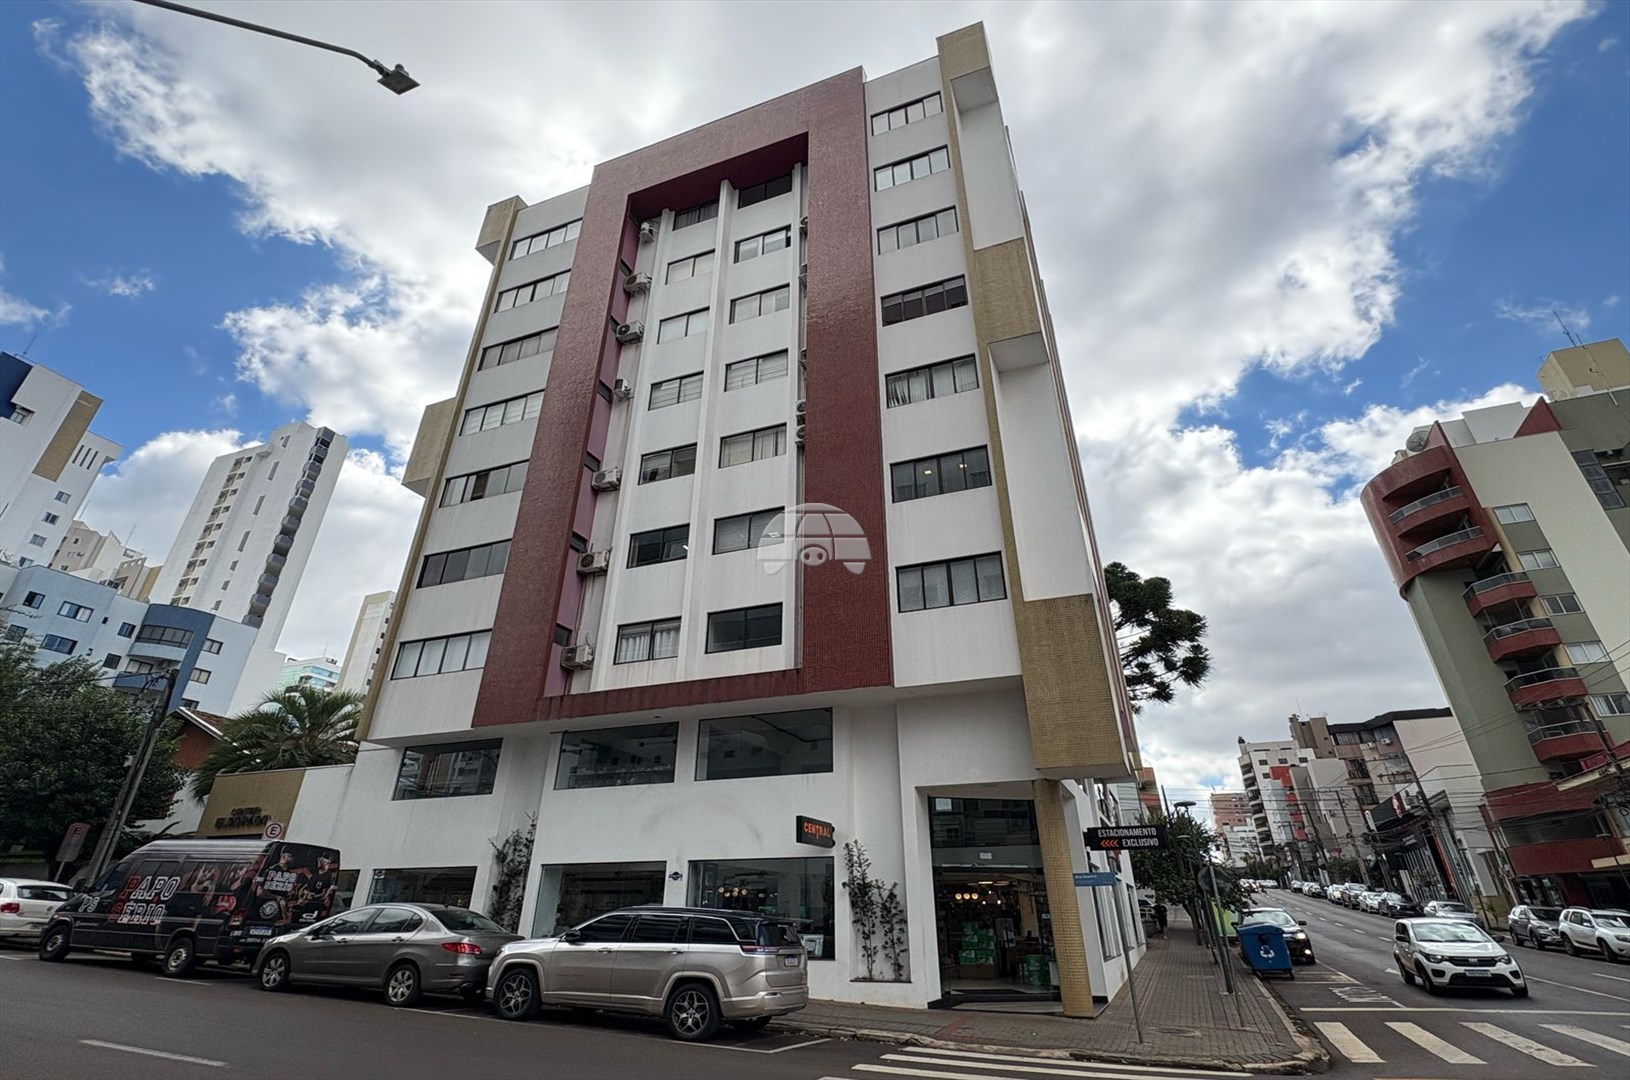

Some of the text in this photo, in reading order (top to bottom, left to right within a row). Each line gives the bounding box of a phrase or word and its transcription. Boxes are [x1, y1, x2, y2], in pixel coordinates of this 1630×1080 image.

[270, 826, 278, 835] E
[803, 821, 831, 838] CENTRAL
[1097, 827, 1157, 837] ESTACIONAMENTO
[1122, 837, 1159, 847] EXCLUSIVO
[119, 876, 180, 900] PAPO
